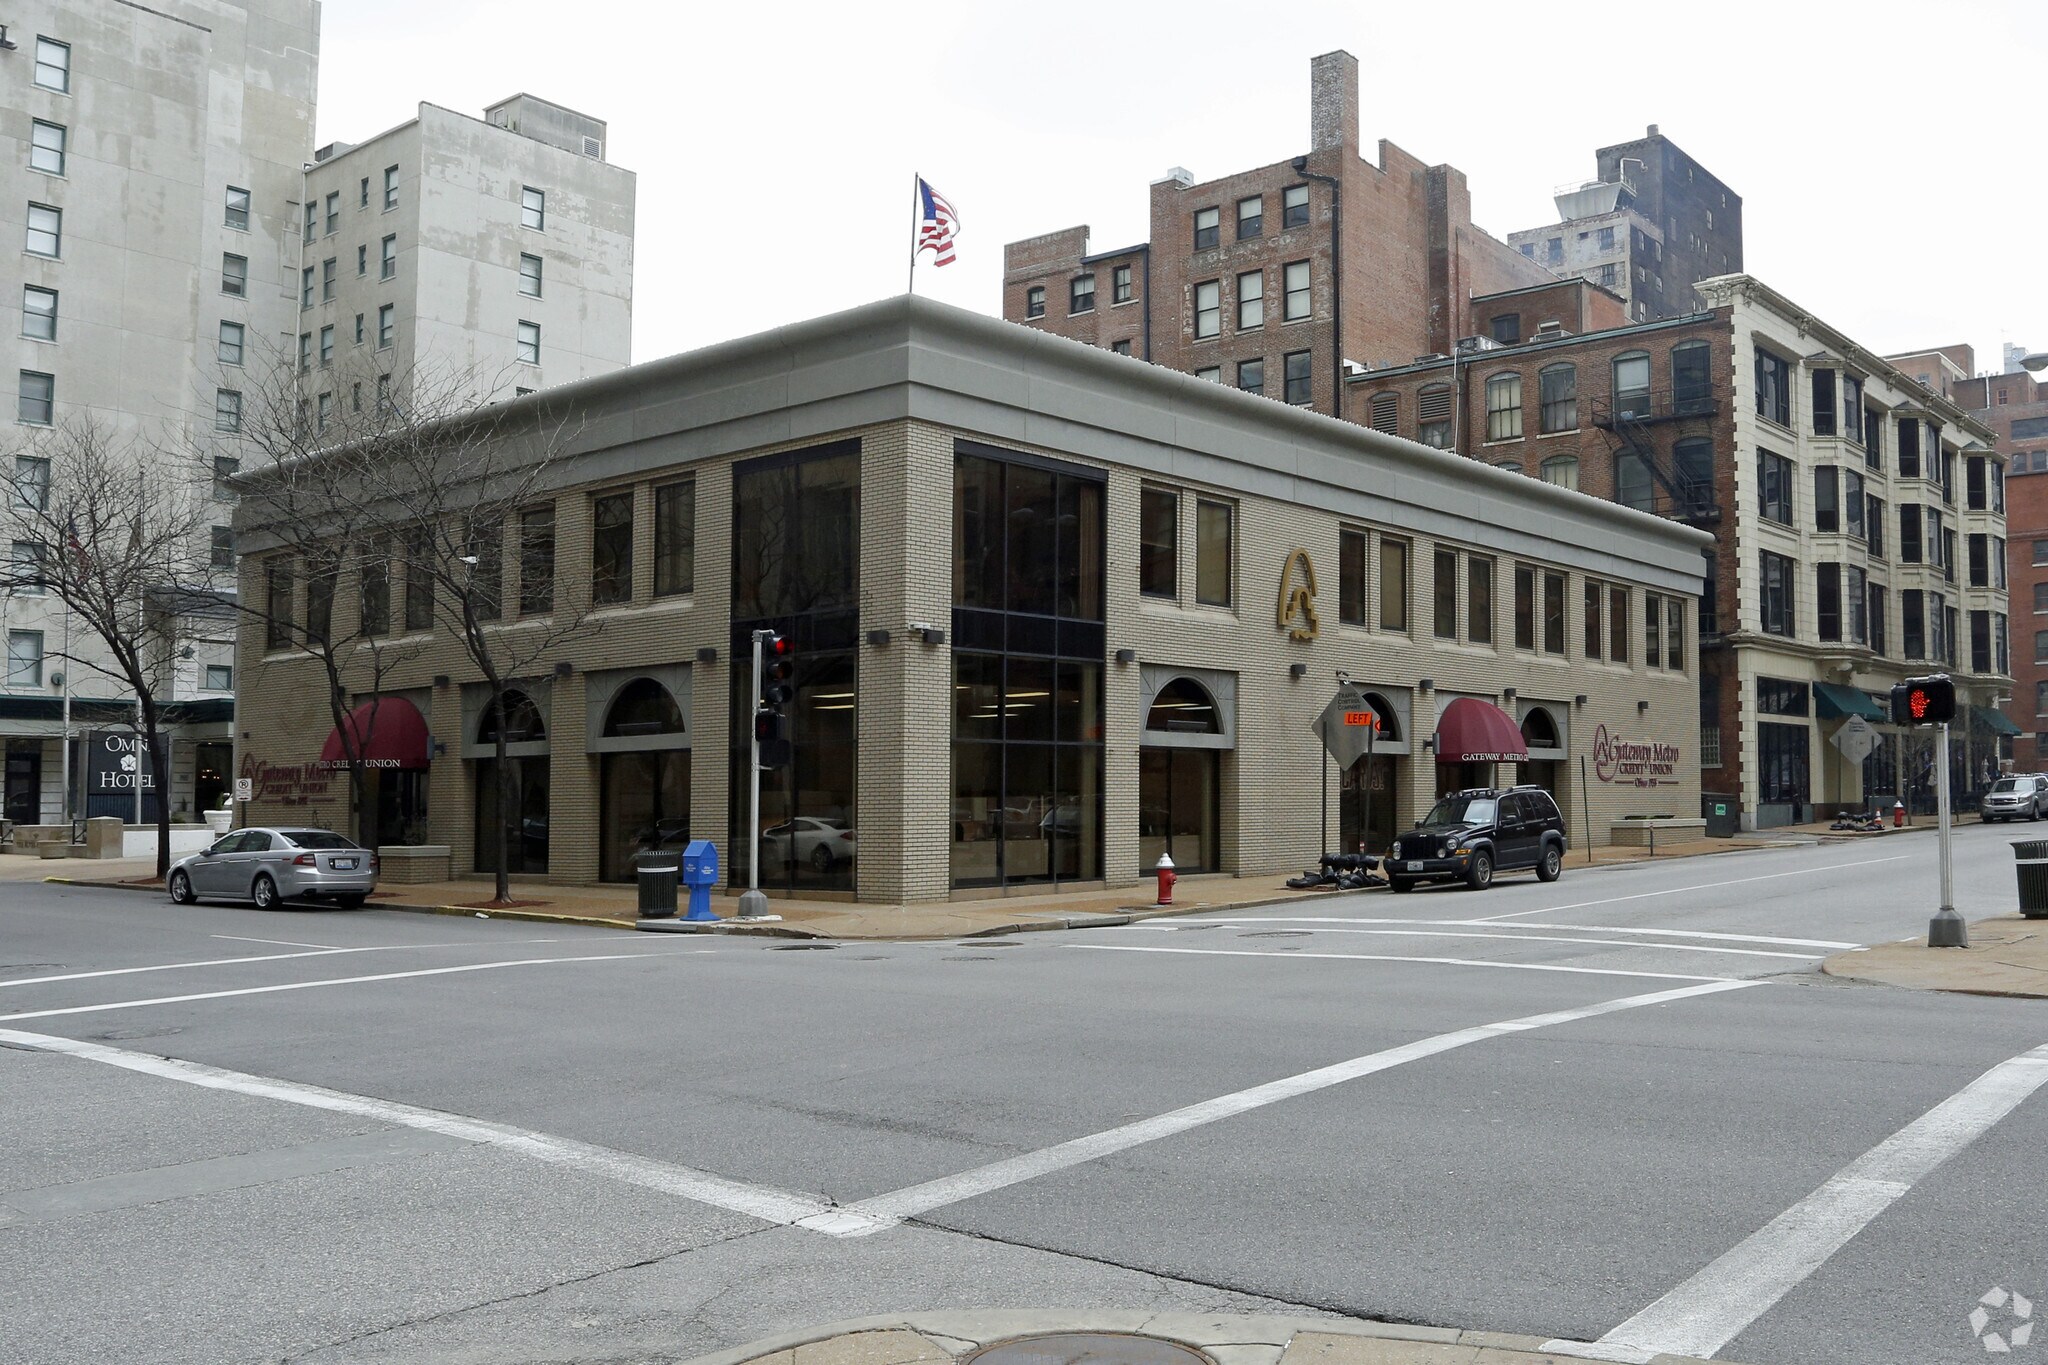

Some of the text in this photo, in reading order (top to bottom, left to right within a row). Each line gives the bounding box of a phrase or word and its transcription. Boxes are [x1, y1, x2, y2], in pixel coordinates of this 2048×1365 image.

[1347, 713, 1369, 724] LEFT
[105, 735, 151, 752] OMN
[1461, 752, 1501, 762] GATEWAY
[1503, 752, 1524, 762] METRO
[1609, 735, 1679, 769] Gateway Metro
[365, 759, 400, 768] UNION
[1619, 763, 1673, 775] CREDIT UNION
